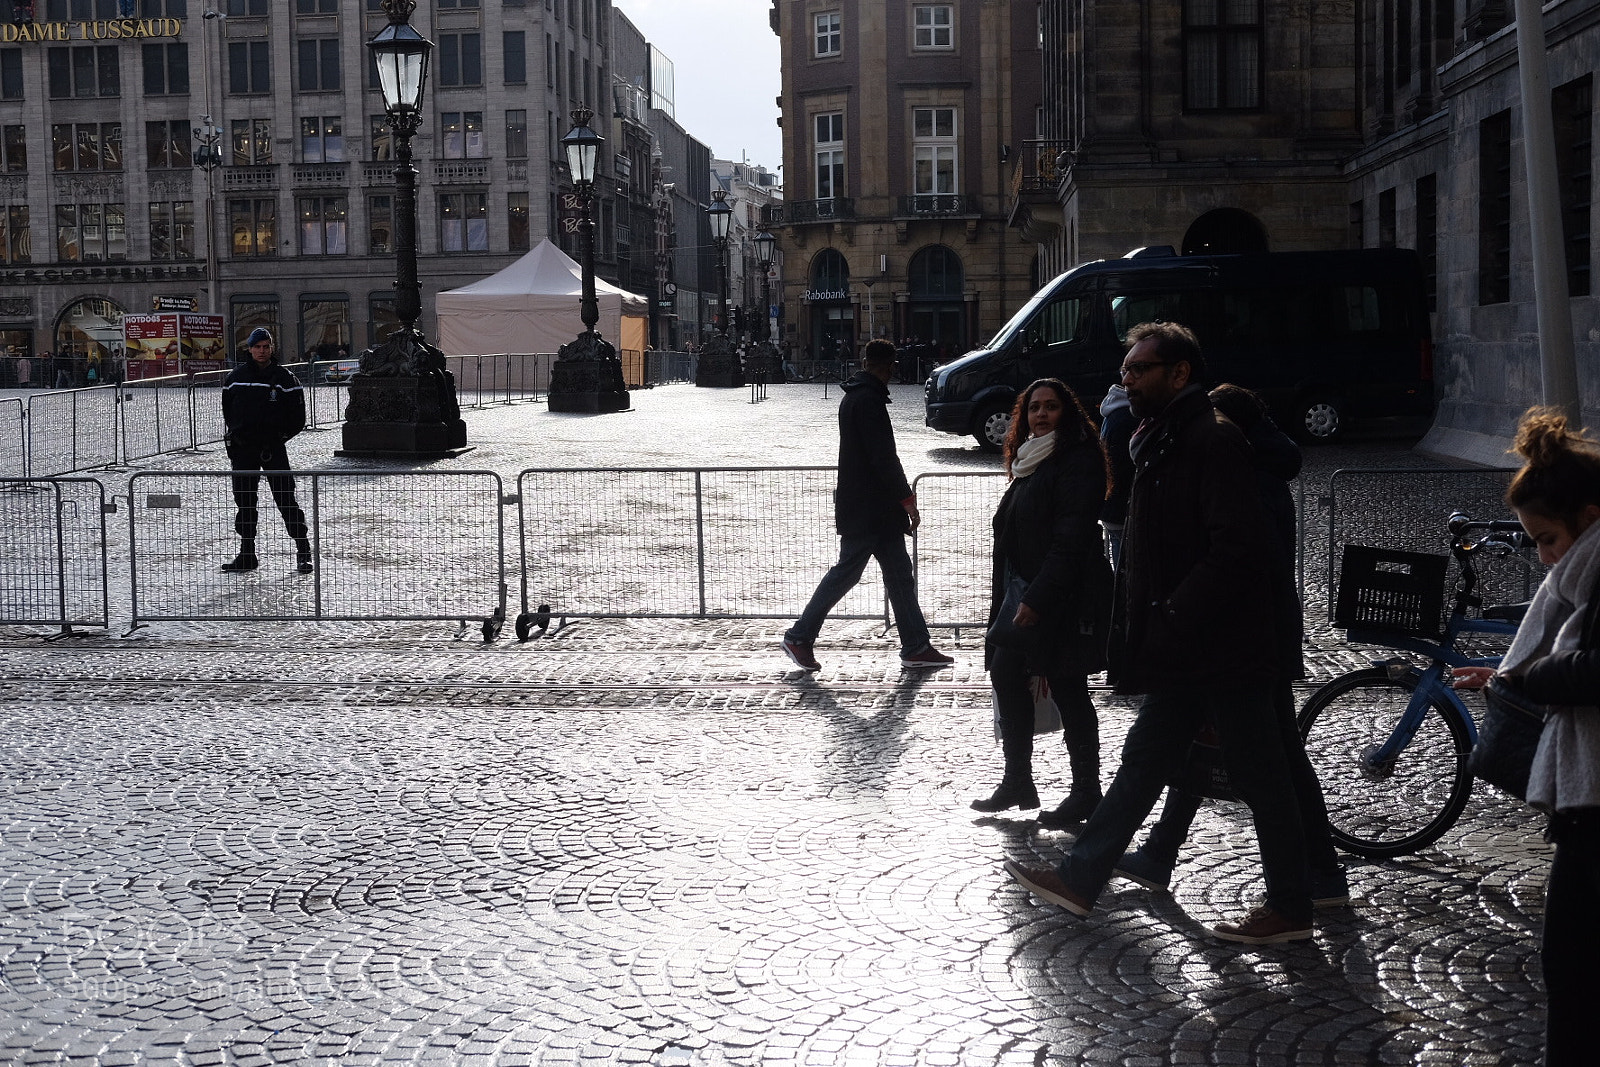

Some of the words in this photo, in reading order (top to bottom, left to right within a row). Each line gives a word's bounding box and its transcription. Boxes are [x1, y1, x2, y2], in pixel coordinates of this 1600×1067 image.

[79, 18, 180, 40] TUSSAUD
[804, 288, 846, 300] Rabobank
[126, 315, 161, 324] HOTDOGS
[184, 315, 209, 325] HOTDOGS
